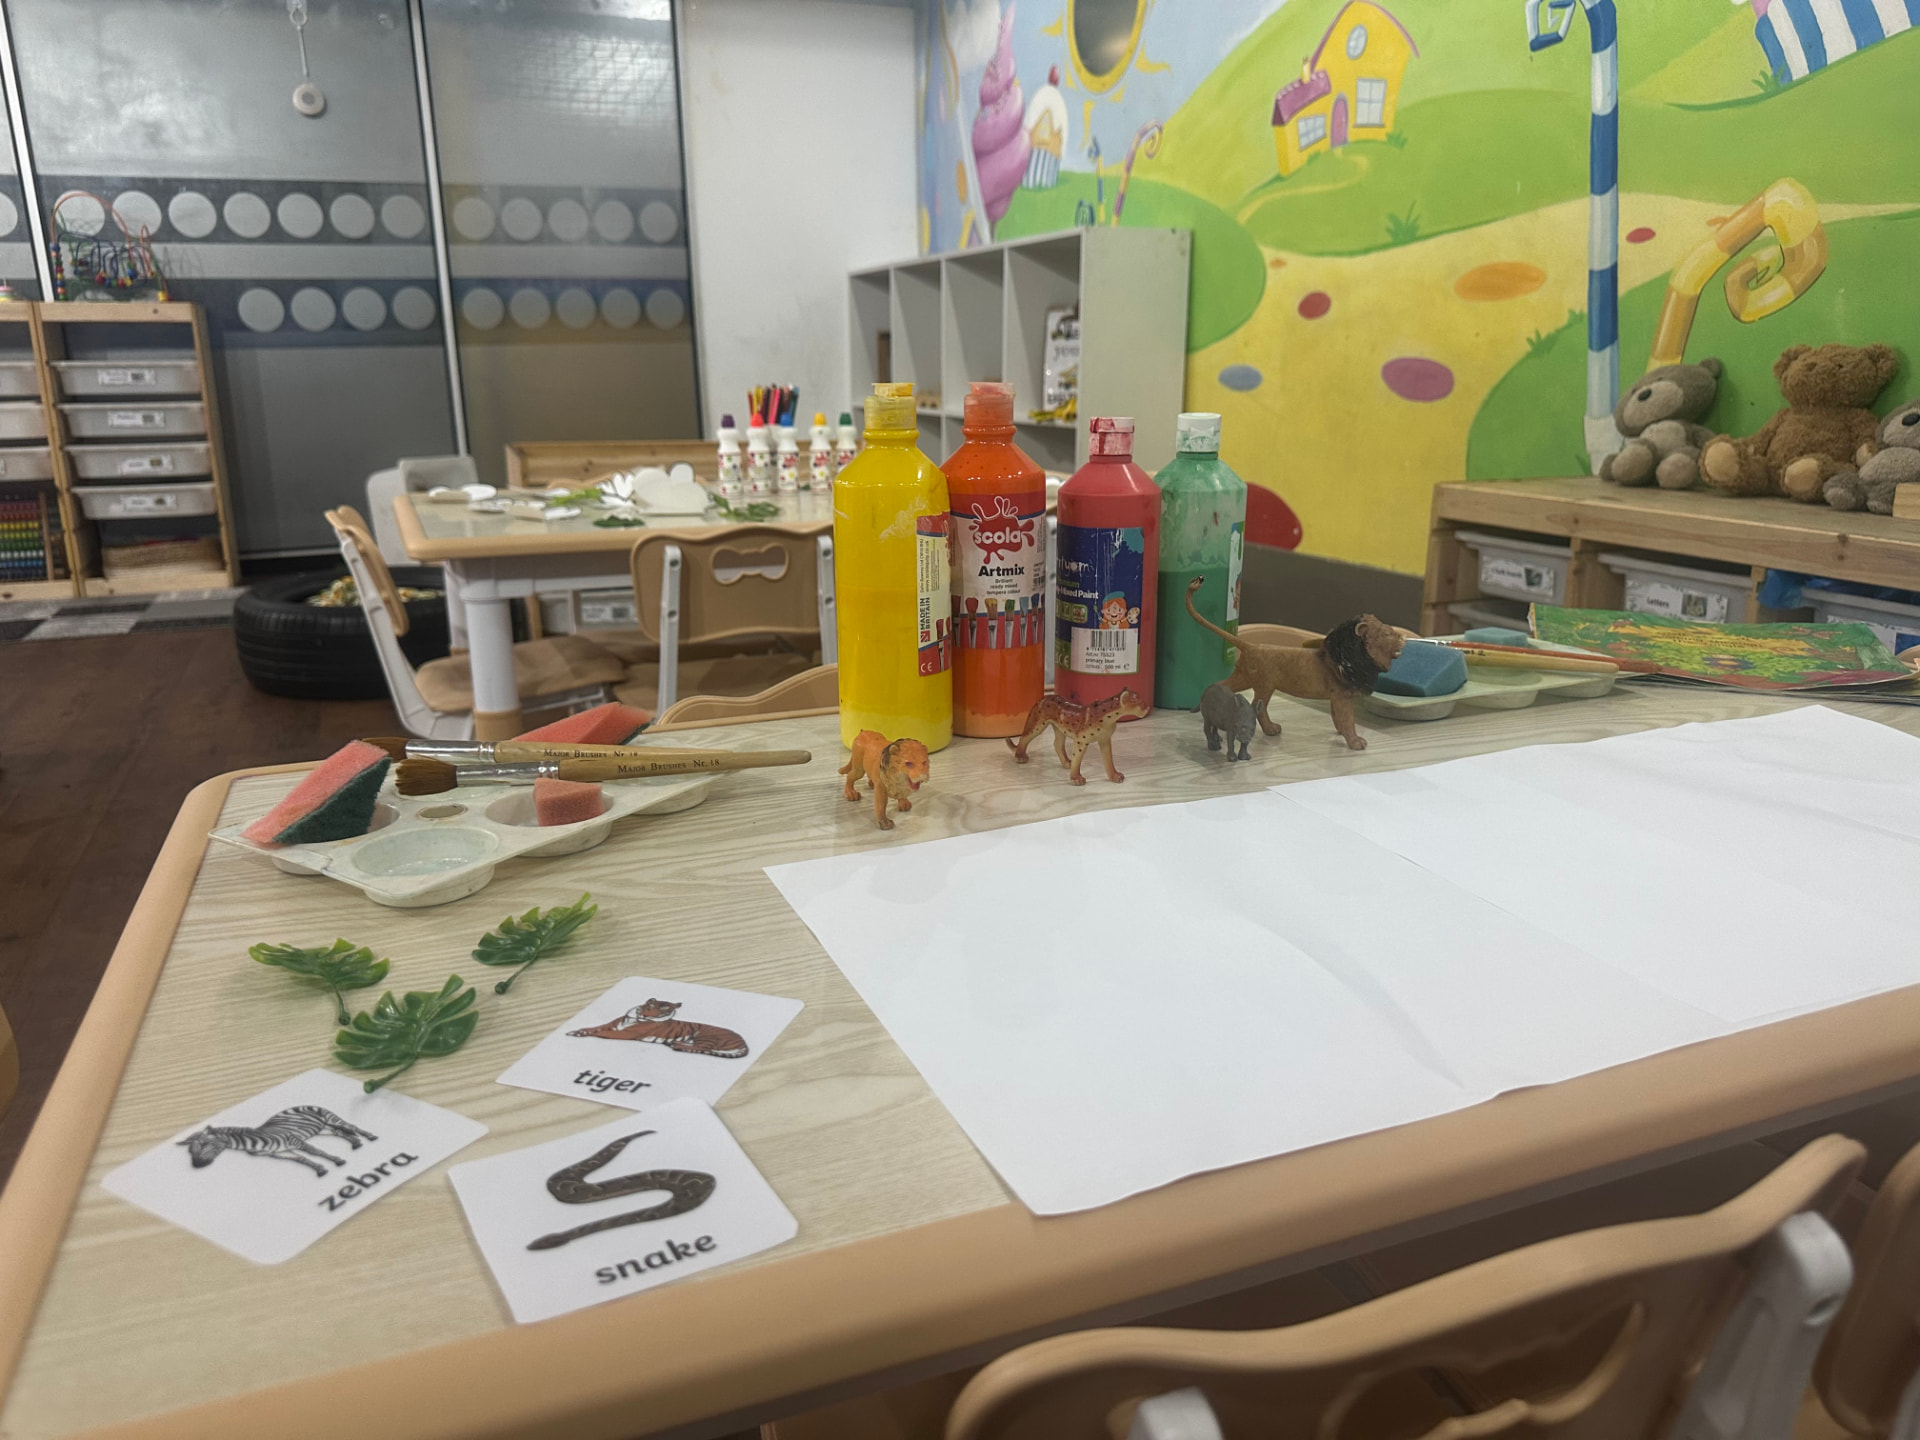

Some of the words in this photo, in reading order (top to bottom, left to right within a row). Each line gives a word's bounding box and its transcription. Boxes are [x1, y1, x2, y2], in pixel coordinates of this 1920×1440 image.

[974, 526, 1021, 545] scola
[978, 563, 1025, 577] Artmix
[1078, 588, 1099, 600] Paint
[710, 758, 720, 767] 18
[573, 1069, 652, 1093] tiger
[318, 1152, 419, 1212] zebra
[595, 1234, 718, 1285] snake
